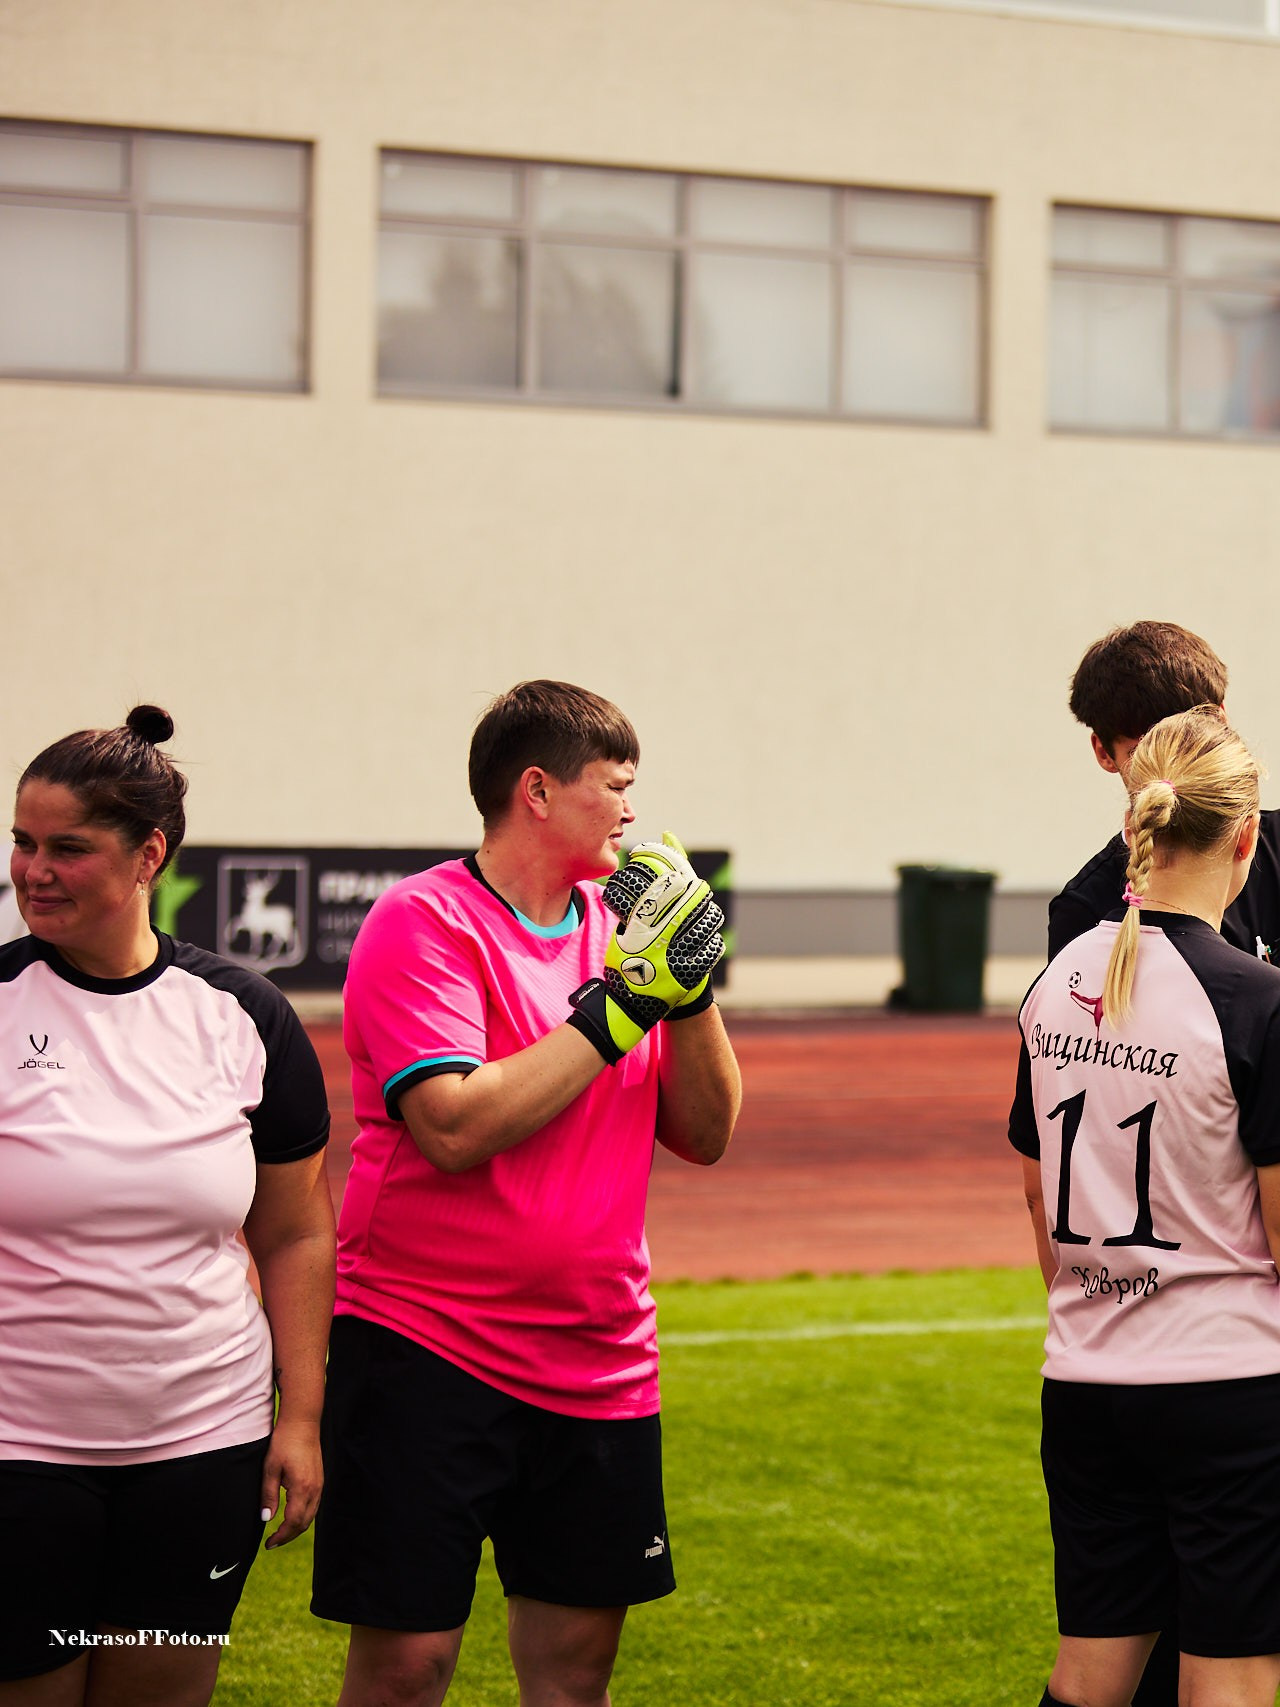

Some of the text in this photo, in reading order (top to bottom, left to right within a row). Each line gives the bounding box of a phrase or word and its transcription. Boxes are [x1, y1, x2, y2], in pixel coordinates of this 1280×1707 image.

[17, 1058, 66, 1070] JÖGEL
[1046, 1089, 1182, 1251] 11
[1071, 1266, 1159, 1305] Ковров
